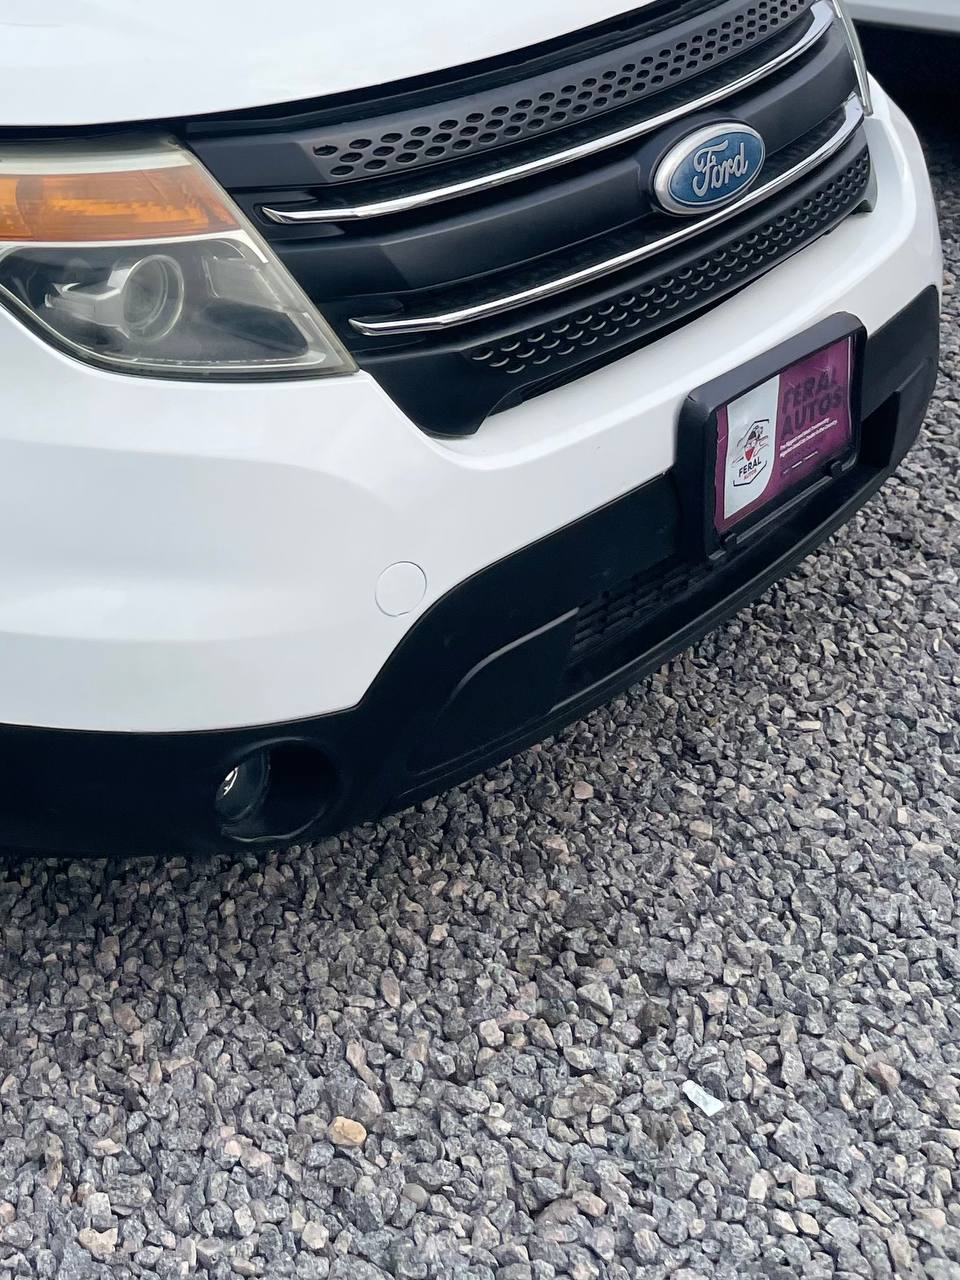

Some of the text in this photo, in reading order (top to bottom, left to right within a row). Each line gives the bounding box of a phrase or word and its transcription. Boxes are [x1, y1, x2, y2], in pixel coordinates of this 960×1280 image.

[692, 140, 748, 197] Ford
[781, 388, 842, 439] AUTOS
[783, 367, 838, 414] FERAL
[738, 456, 762, 477] FERAL
